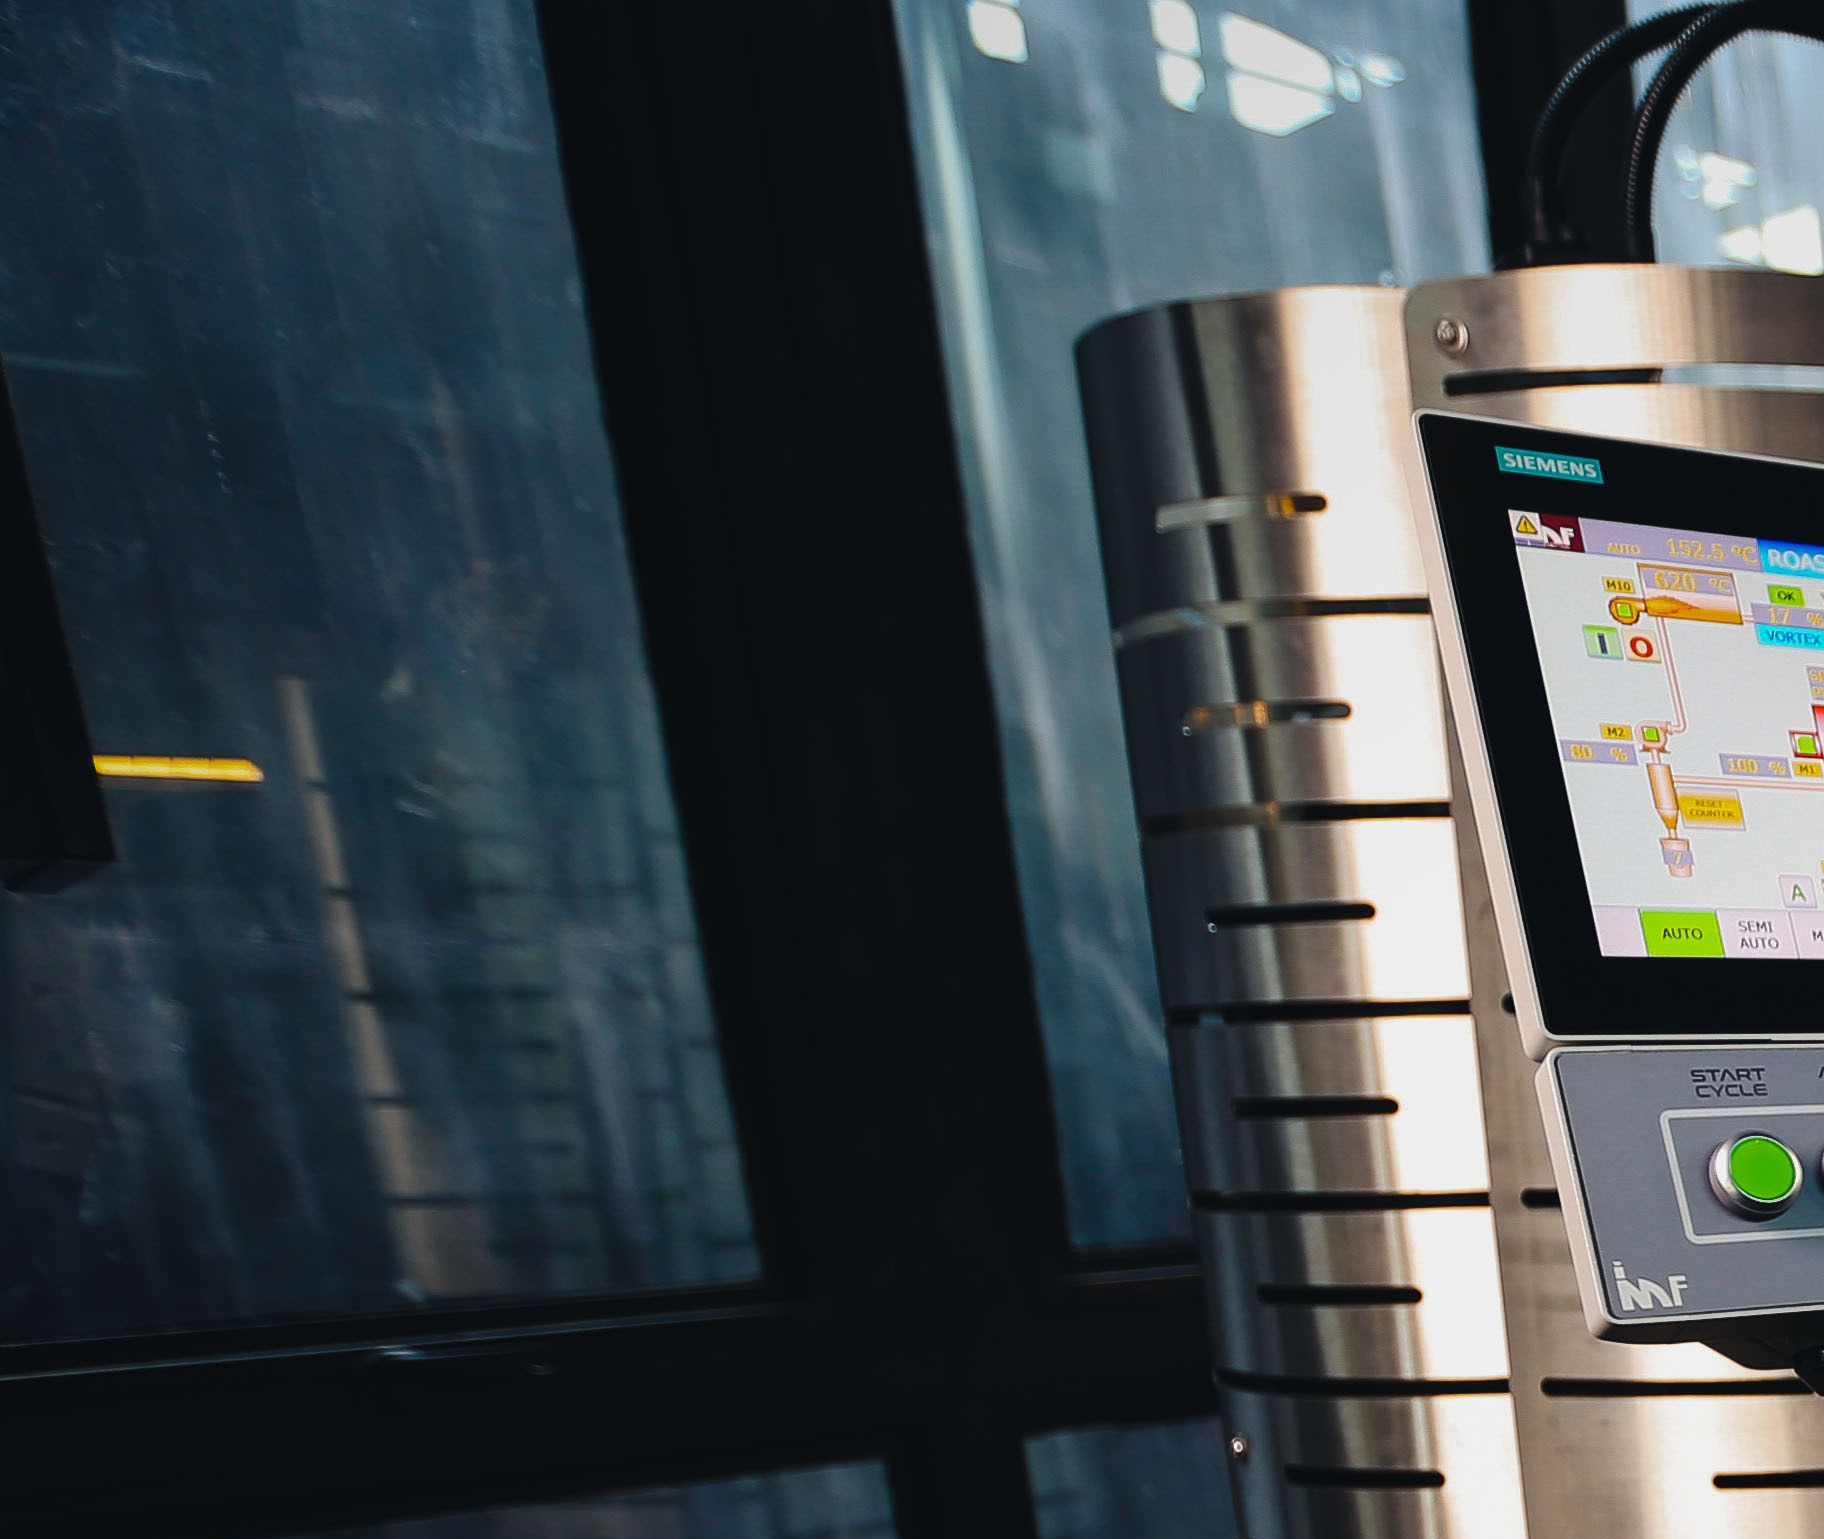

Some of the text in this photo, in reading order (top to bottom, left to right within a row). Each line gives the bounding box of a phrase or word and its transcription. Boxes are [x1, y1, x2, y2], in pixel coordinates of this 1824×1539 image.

[1503, 453, 1597, 478] SIEMENS
[1607, 543, 1640, 554] AUTO
[1667, 538, 1725, 561] 152.5
[1606, 579, 1631, 591] M10
[1654, 571, 1696, 592] 620
[1778, 590, 1796, 601] OK
[1768, 607, 1790, 625] 17
[1765, 629, 1822, 646] VORTEX
[1607, 727, 1624, 736] M2
[1610, 748, 1628, 761] %
[1728, 759, 1786, 775] 100 %
[1792, 883, 1807, 901] A
[1662, 928, 1703, 940] AUTO
[1738, 920, 1773, 933] SEMI
[1740, 937, 1779, 949] AUTO
[1690, 1067, 1765, 1083] START
[1695, 1083, 1768, 1098] CYCLE
